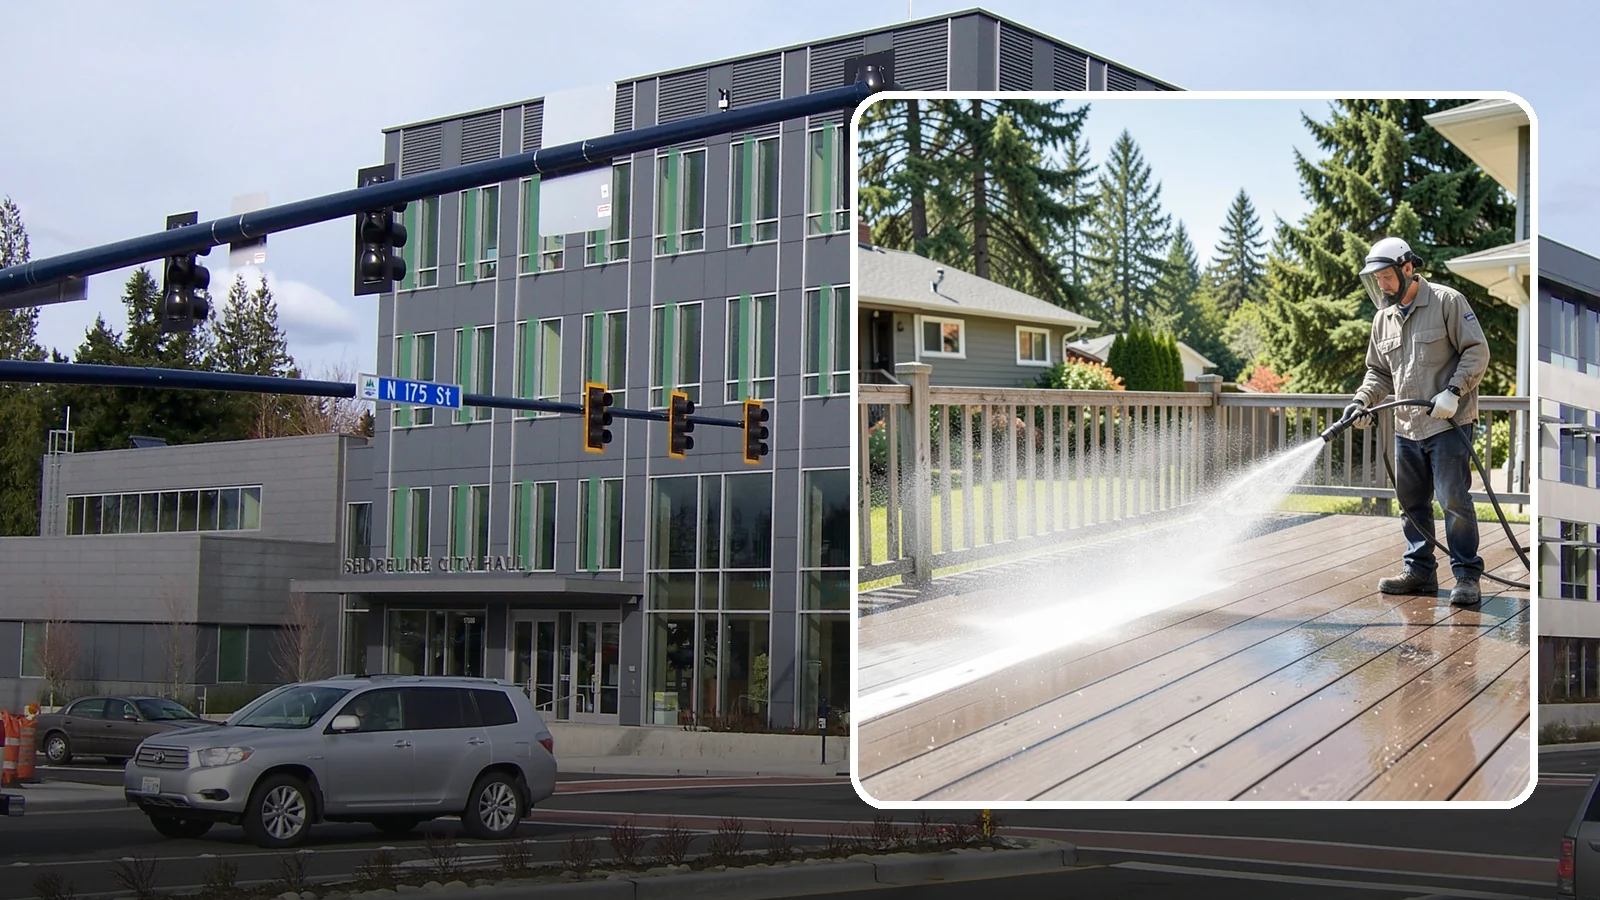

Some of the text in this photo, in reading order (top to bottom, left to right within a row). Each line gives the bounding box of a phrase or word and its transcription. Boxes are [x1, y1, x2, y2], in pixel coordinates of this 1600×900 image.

[387, 381, 451, 406] N 175 St
[343, 555, 525, 574] SHORELINE CITY HALL
